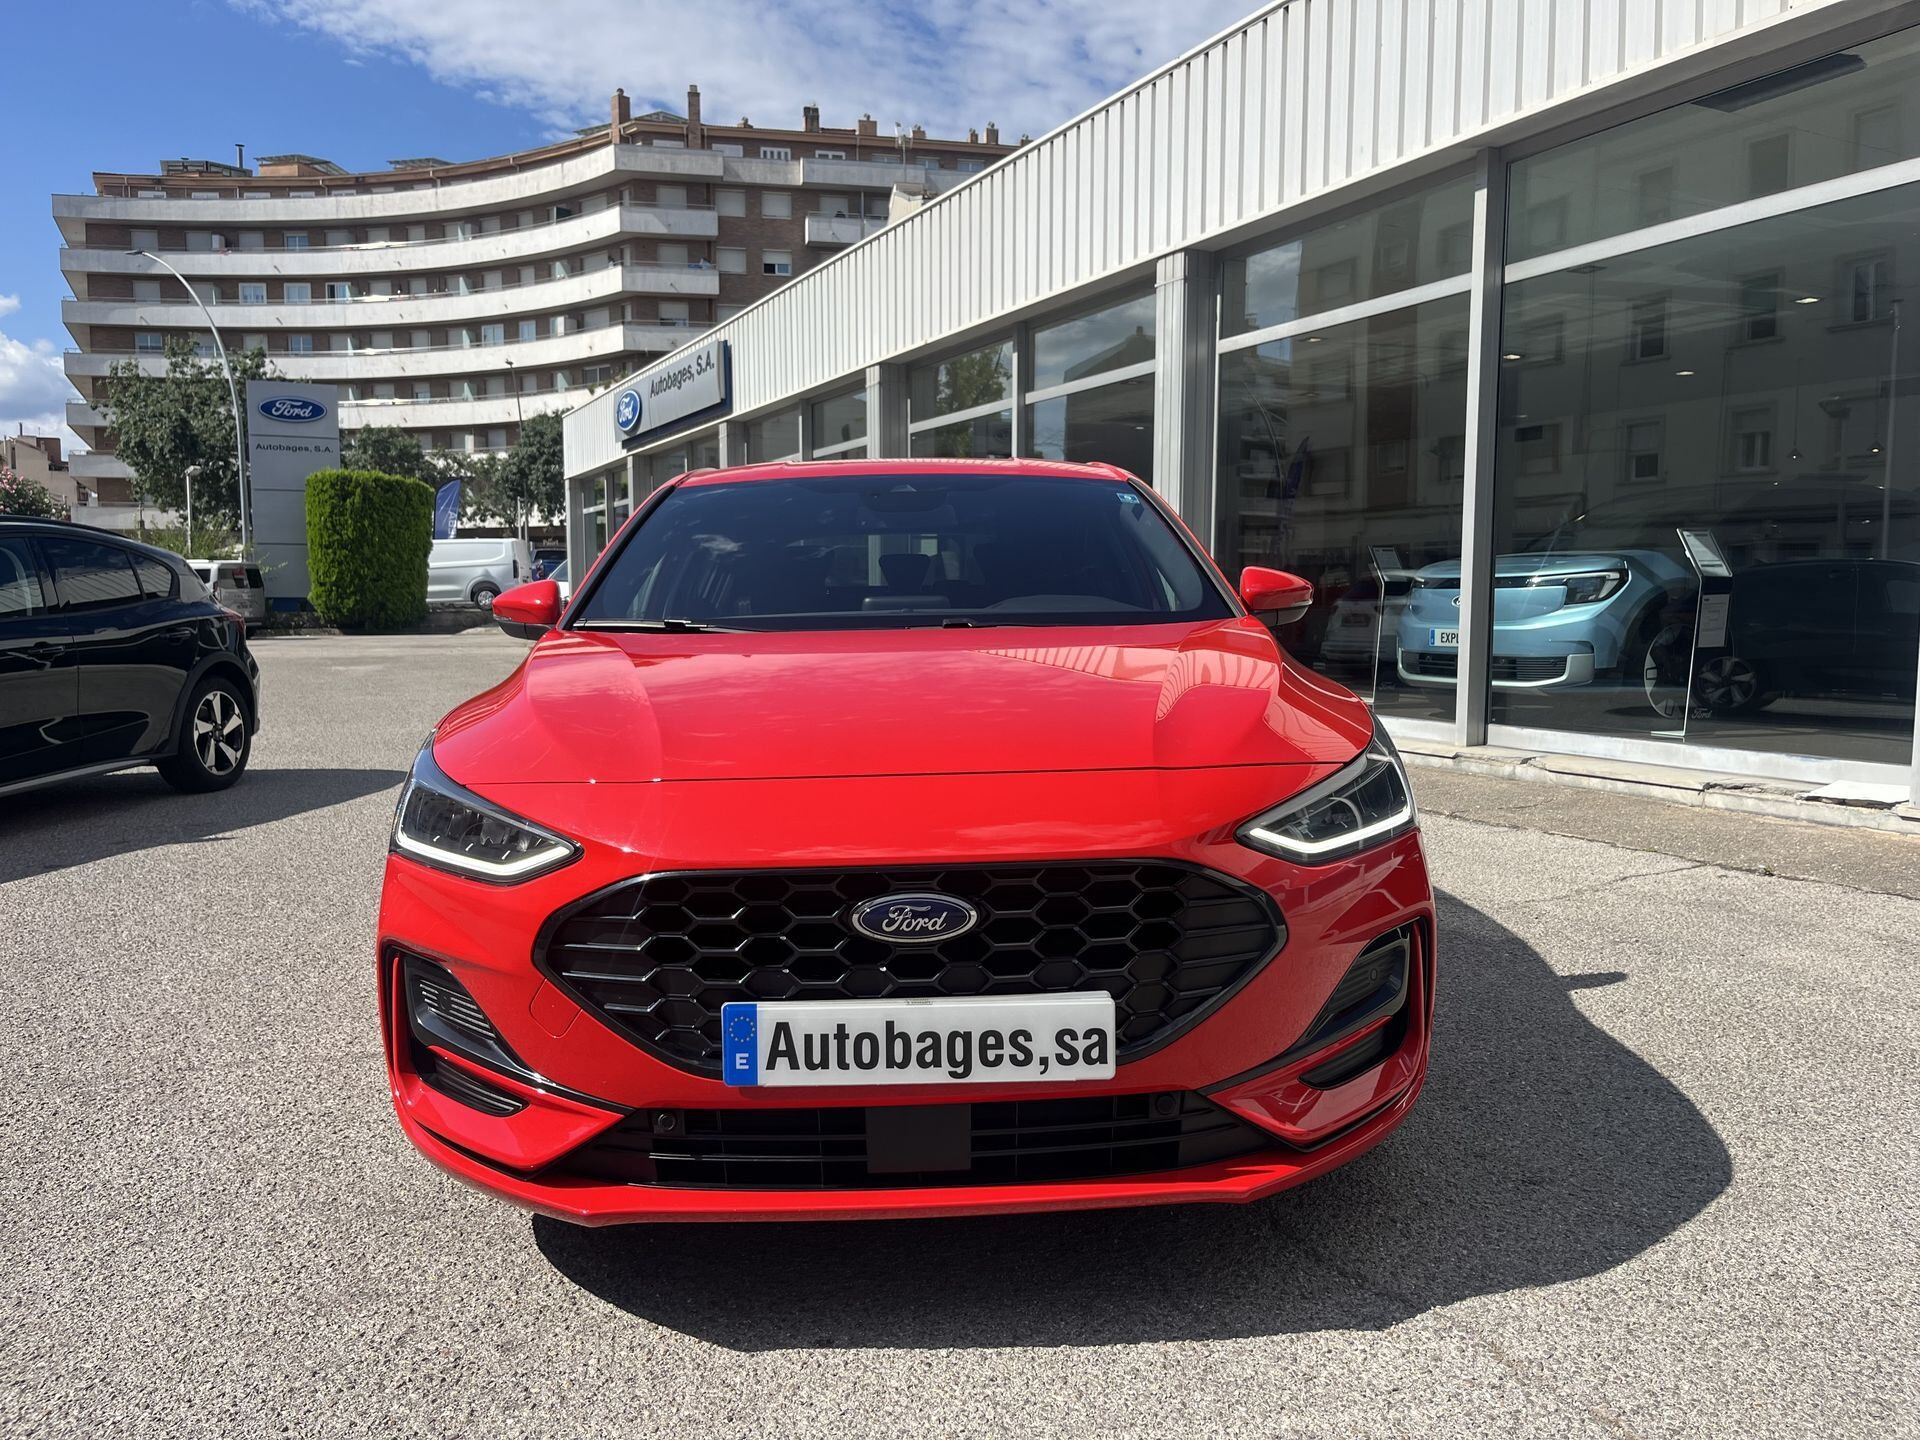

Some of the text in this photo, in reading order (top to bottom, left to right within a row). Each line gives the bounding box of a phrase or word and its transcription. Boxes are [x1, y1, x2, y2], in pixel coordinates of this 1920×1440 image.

[650, 350, 715, 398] Autobages, S.A.
[271, 400, 312, 417] Ford
[619, 396, 634, 424] Ford
[314, 445, 334, 454] S.A.
[1691, 707, 1713, 719] Ford
[881, 905, 947, 932] Ford
[735, 1052, 749, 1070] E
[765, 1020, 1109, 1080] Autobages,sa
